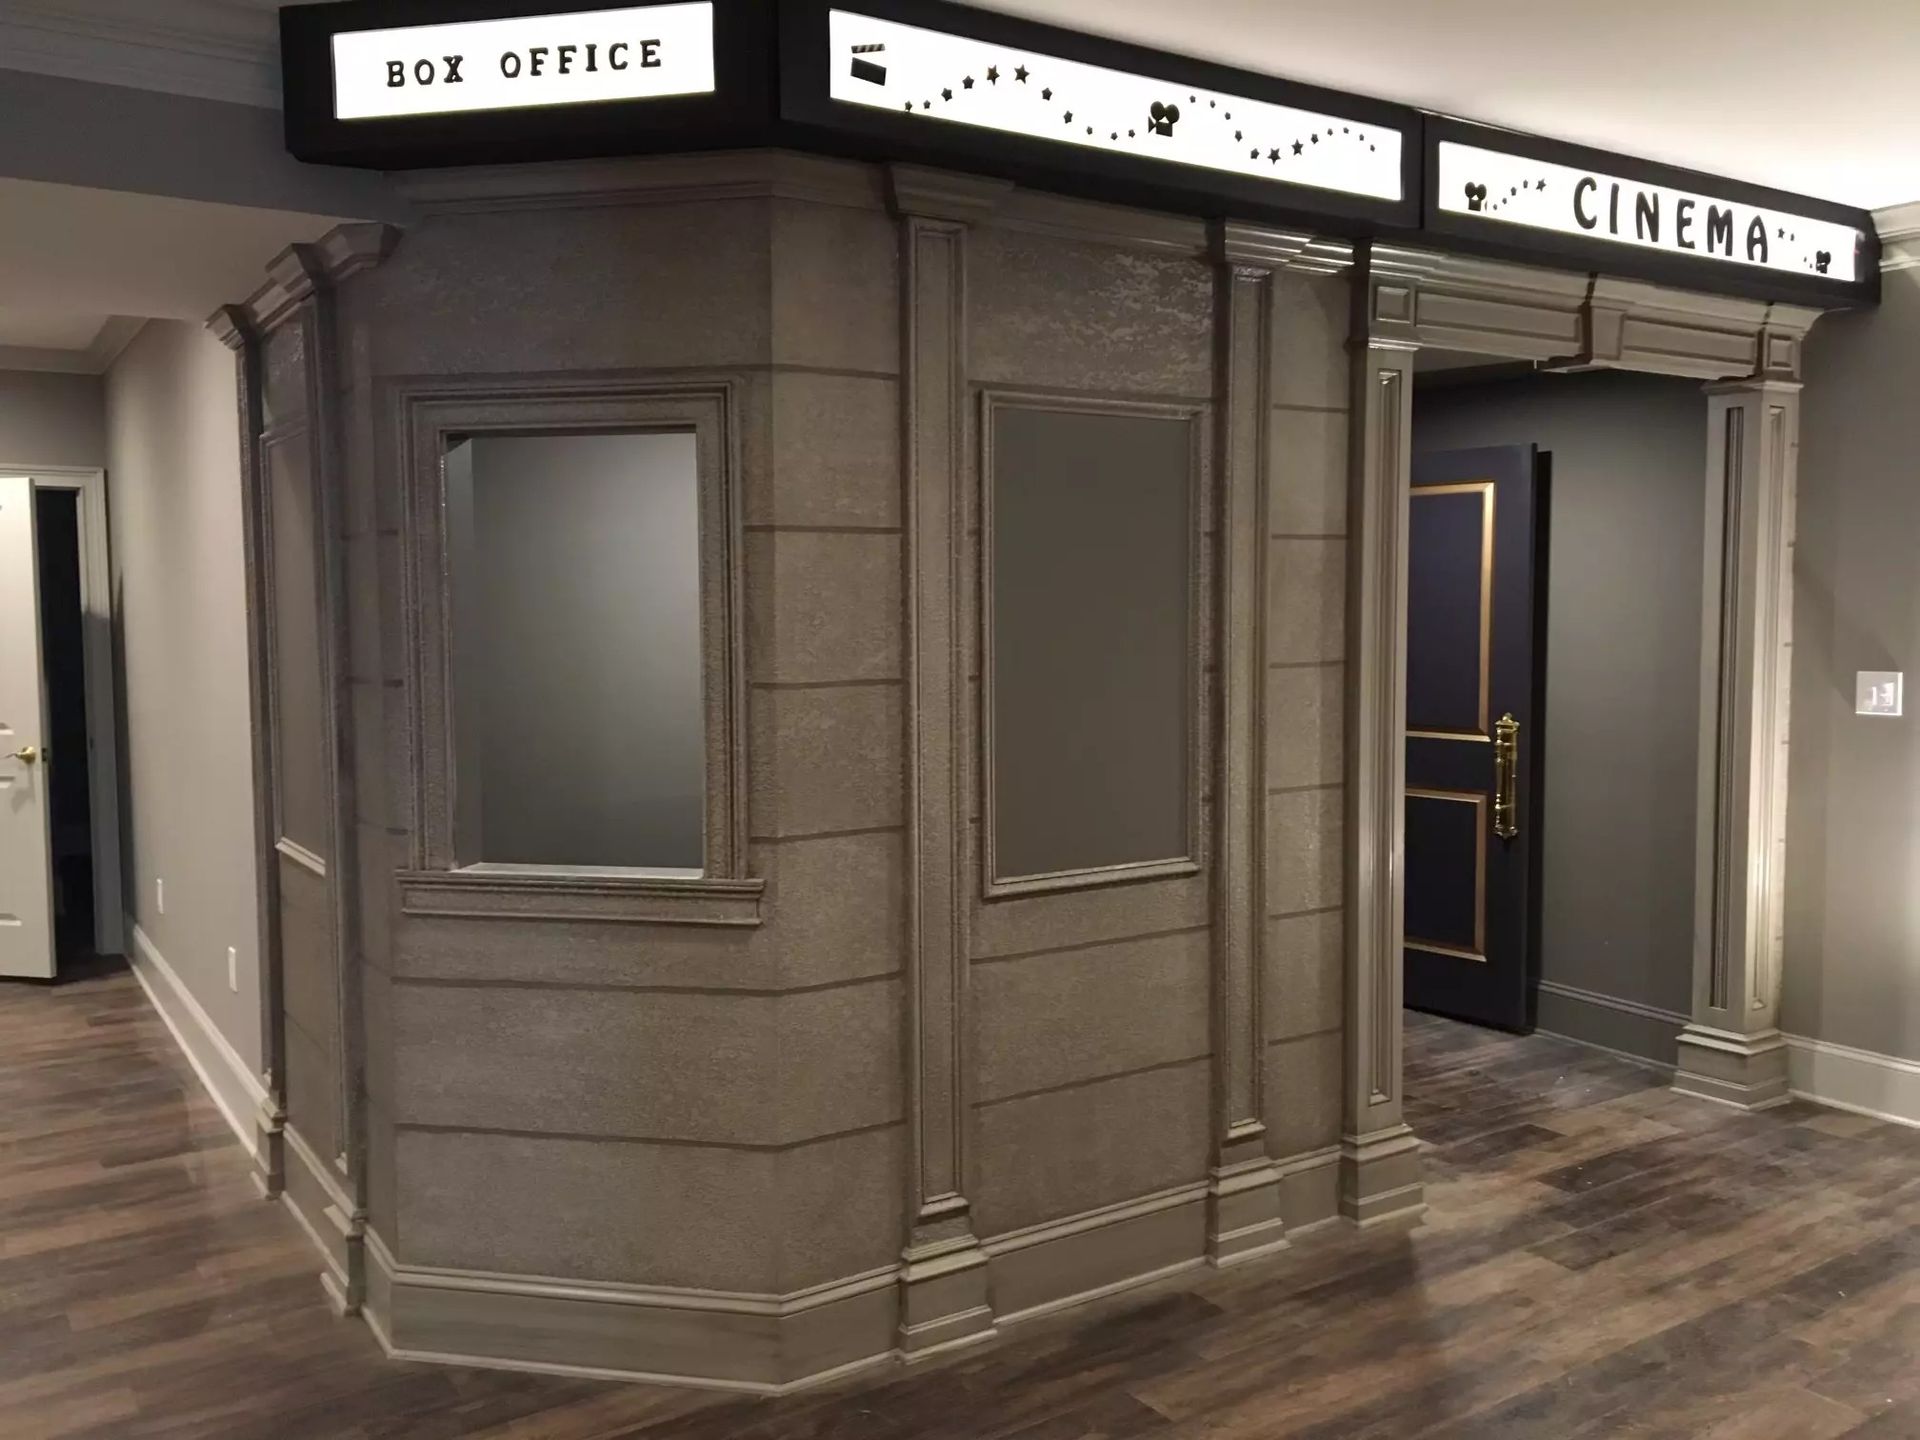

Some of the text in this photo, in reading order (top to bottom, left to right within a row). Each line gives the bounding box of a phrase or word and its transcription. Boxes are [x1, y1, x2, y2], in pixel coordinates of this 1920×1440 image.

[386, 40, 661, 86] BOX OFFICE
[1573, 176, 1768, 264] CINEMA
